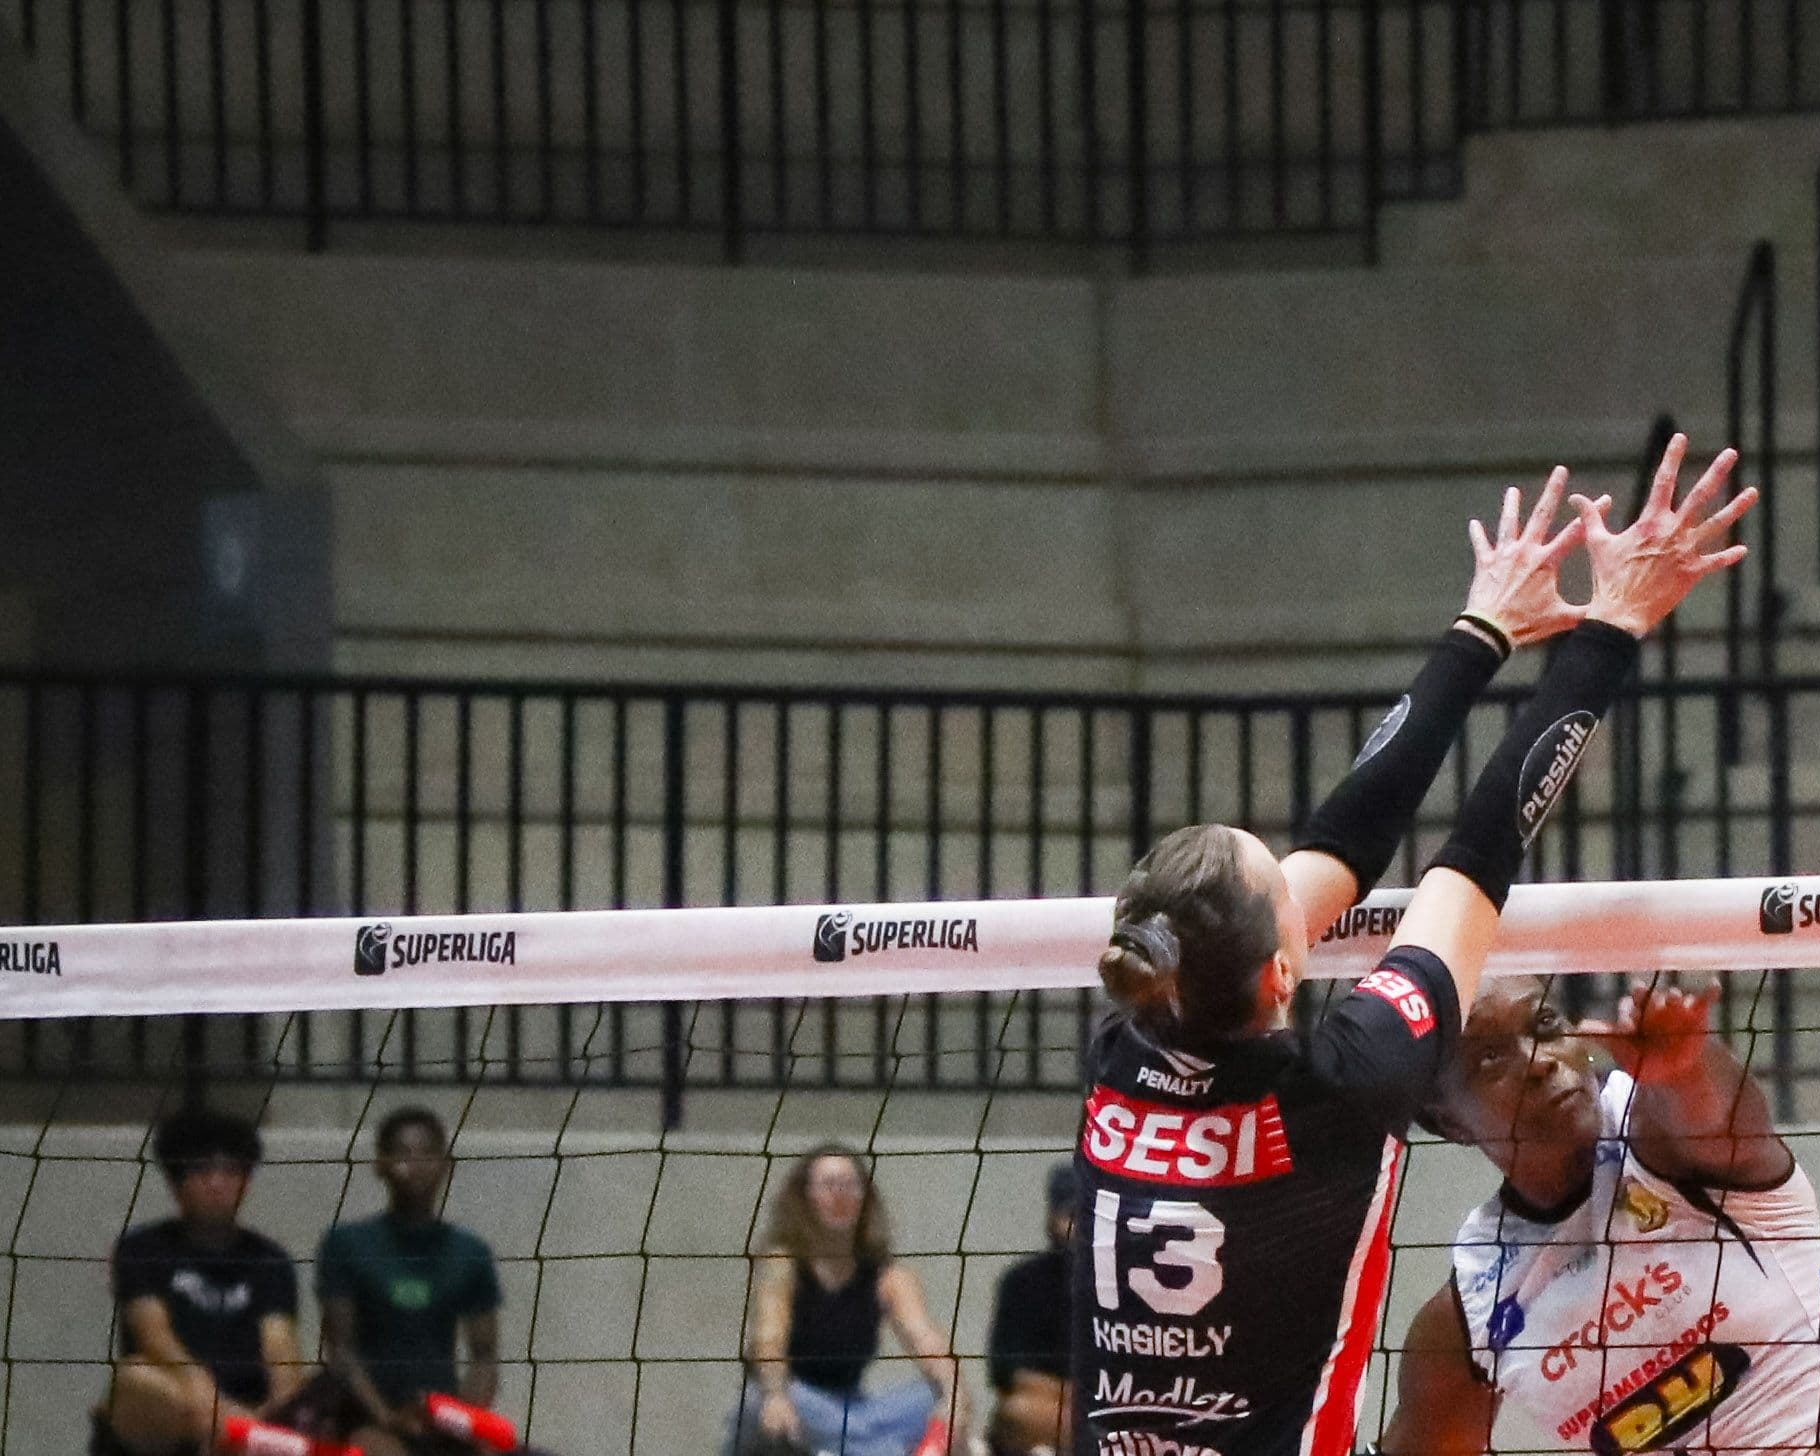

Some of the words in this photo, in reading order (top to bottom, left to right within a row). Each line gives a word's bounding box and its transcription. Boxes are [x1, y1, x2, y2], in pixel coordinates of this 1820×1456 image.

[391, 931, 517, 969] SUPERLIGA
[851, 918, 979, 956] SUPERLIGA
[1136, 1066, 1214, 1096] PENALTY
[1090, 1104, 1257, 1179] SESI
[1092, 1189, 1226, 1317] 13
[1092, 1316, 1232, 1358] KASIELY
[1541, 1262, 1684, 1383] crock's
